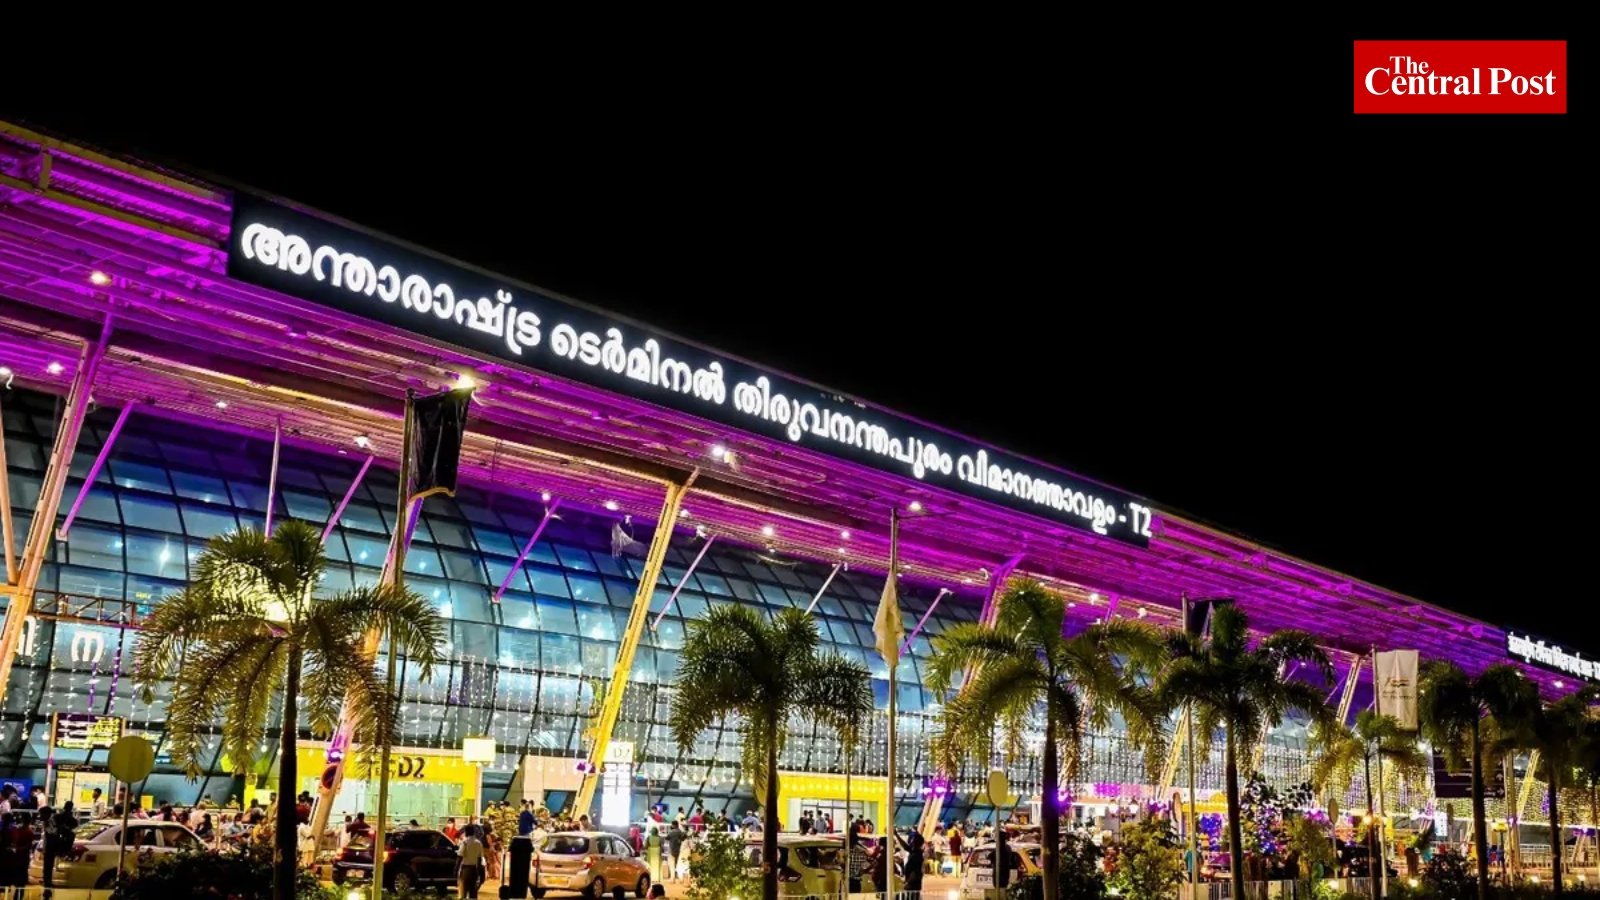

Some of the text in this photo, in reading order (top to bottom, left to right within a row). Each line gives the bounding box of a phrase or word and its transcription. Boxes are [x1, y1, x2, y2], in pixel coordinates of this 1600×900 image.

[241, 222, 541, 355] അന്താരാഷ്ട്ര
[551, 323, 727, 405] ടെർമിനൽ
[733, 376, 953, 480] തിരുവനന്തപുരം
[957, 449, 1117, 535] വിമാനത്താവളം
[1129, 502, 1153, 538] T2
[398, 756, 425, 779] D2
